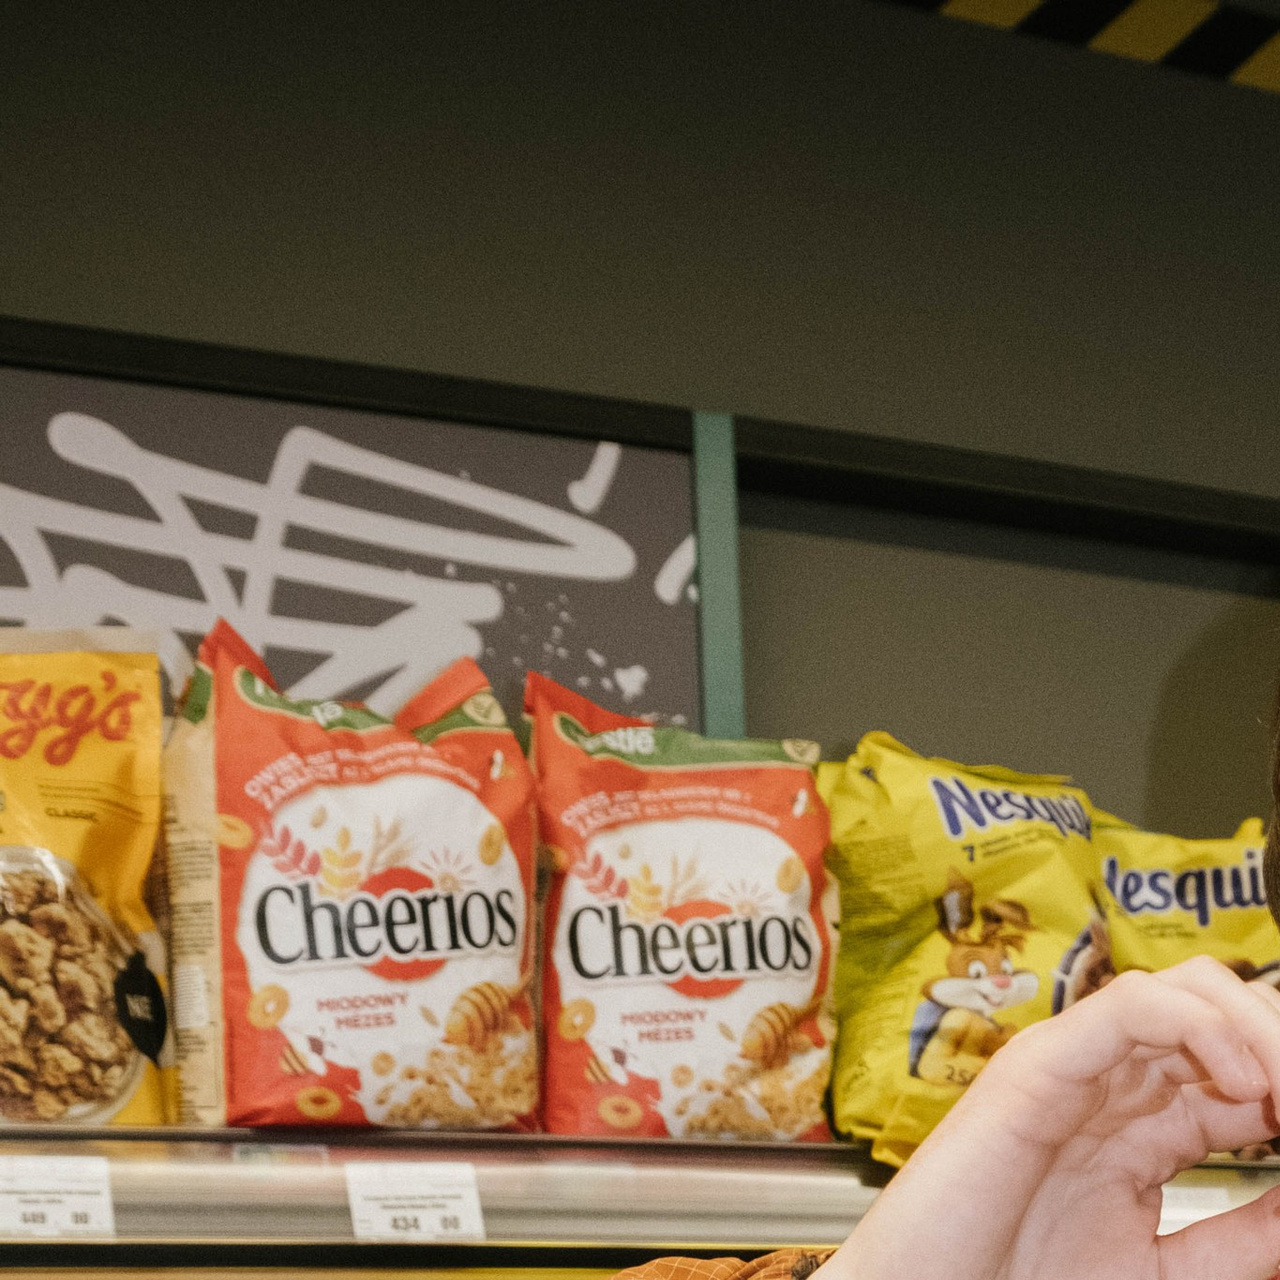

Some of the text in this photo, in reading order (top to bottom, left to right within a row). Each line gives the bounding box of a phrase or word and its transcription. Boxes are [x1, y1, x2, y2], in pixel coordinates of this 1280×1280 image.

[0, 671, 141, 766] gg's
[256, 883, 517, 965] Cheerios
[1105, 850, 1267, 926] esqui
[569, 904, 812, 980] Cheerios
[317, 992, 408, 1012] MIODOWY
